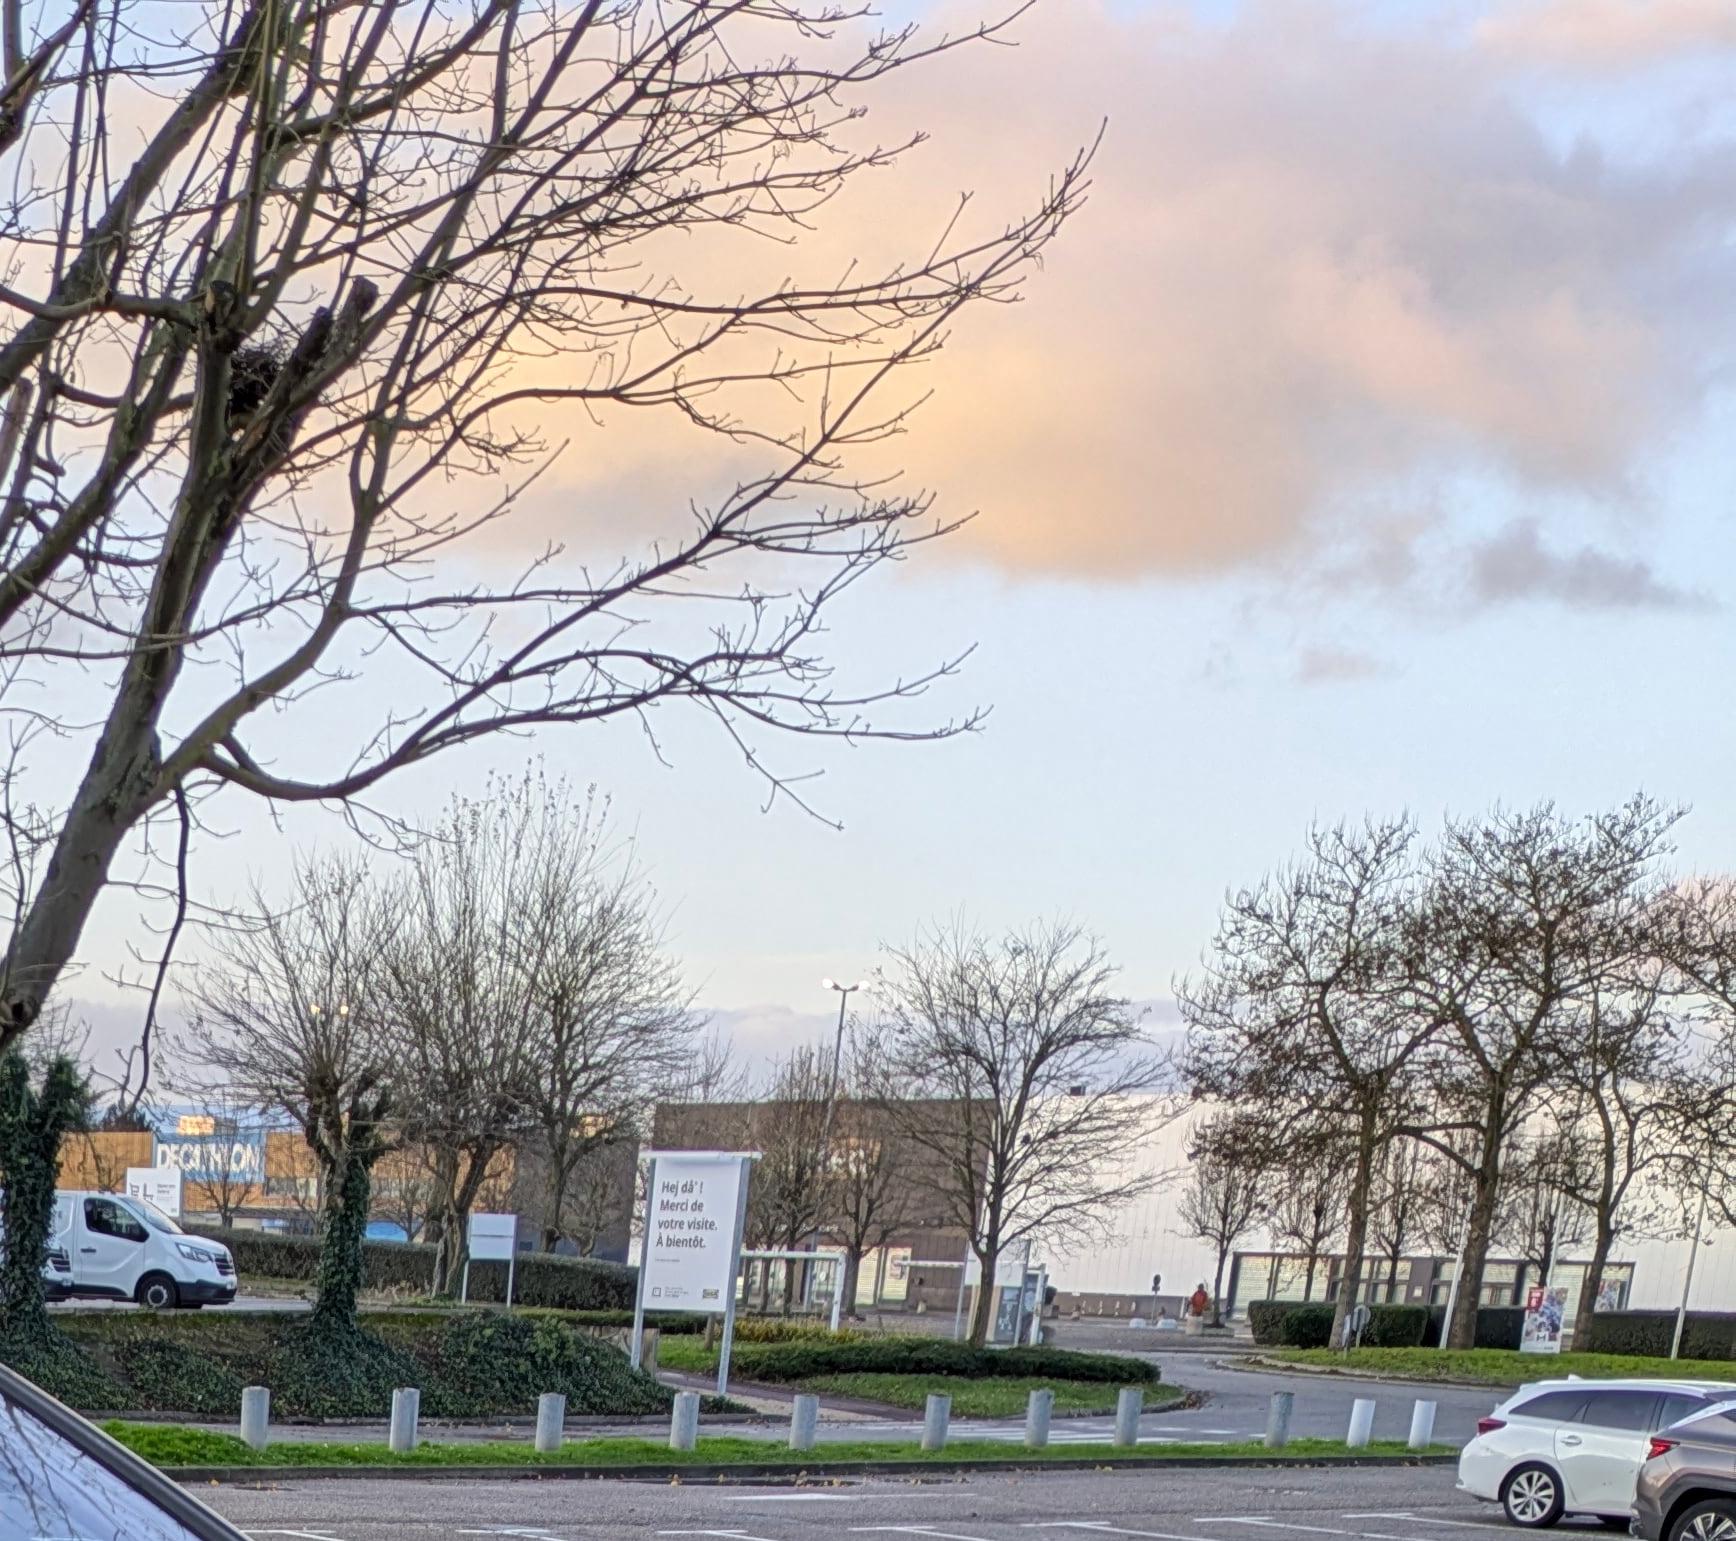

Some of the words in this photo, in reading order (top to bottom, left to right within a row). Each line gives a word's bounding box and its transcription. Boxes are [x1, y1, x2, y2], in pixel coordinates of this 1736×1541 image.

[661, 1181, 679, 1197] Hej
[660, 1199, 688, 1211] Merci
[690, 1200, 704, 1212] de
[658, 1218, 685, 1230] votre
[687, 1217, 718, 1231] visite.
[666, 1235, 706, 1248] bientôt.
